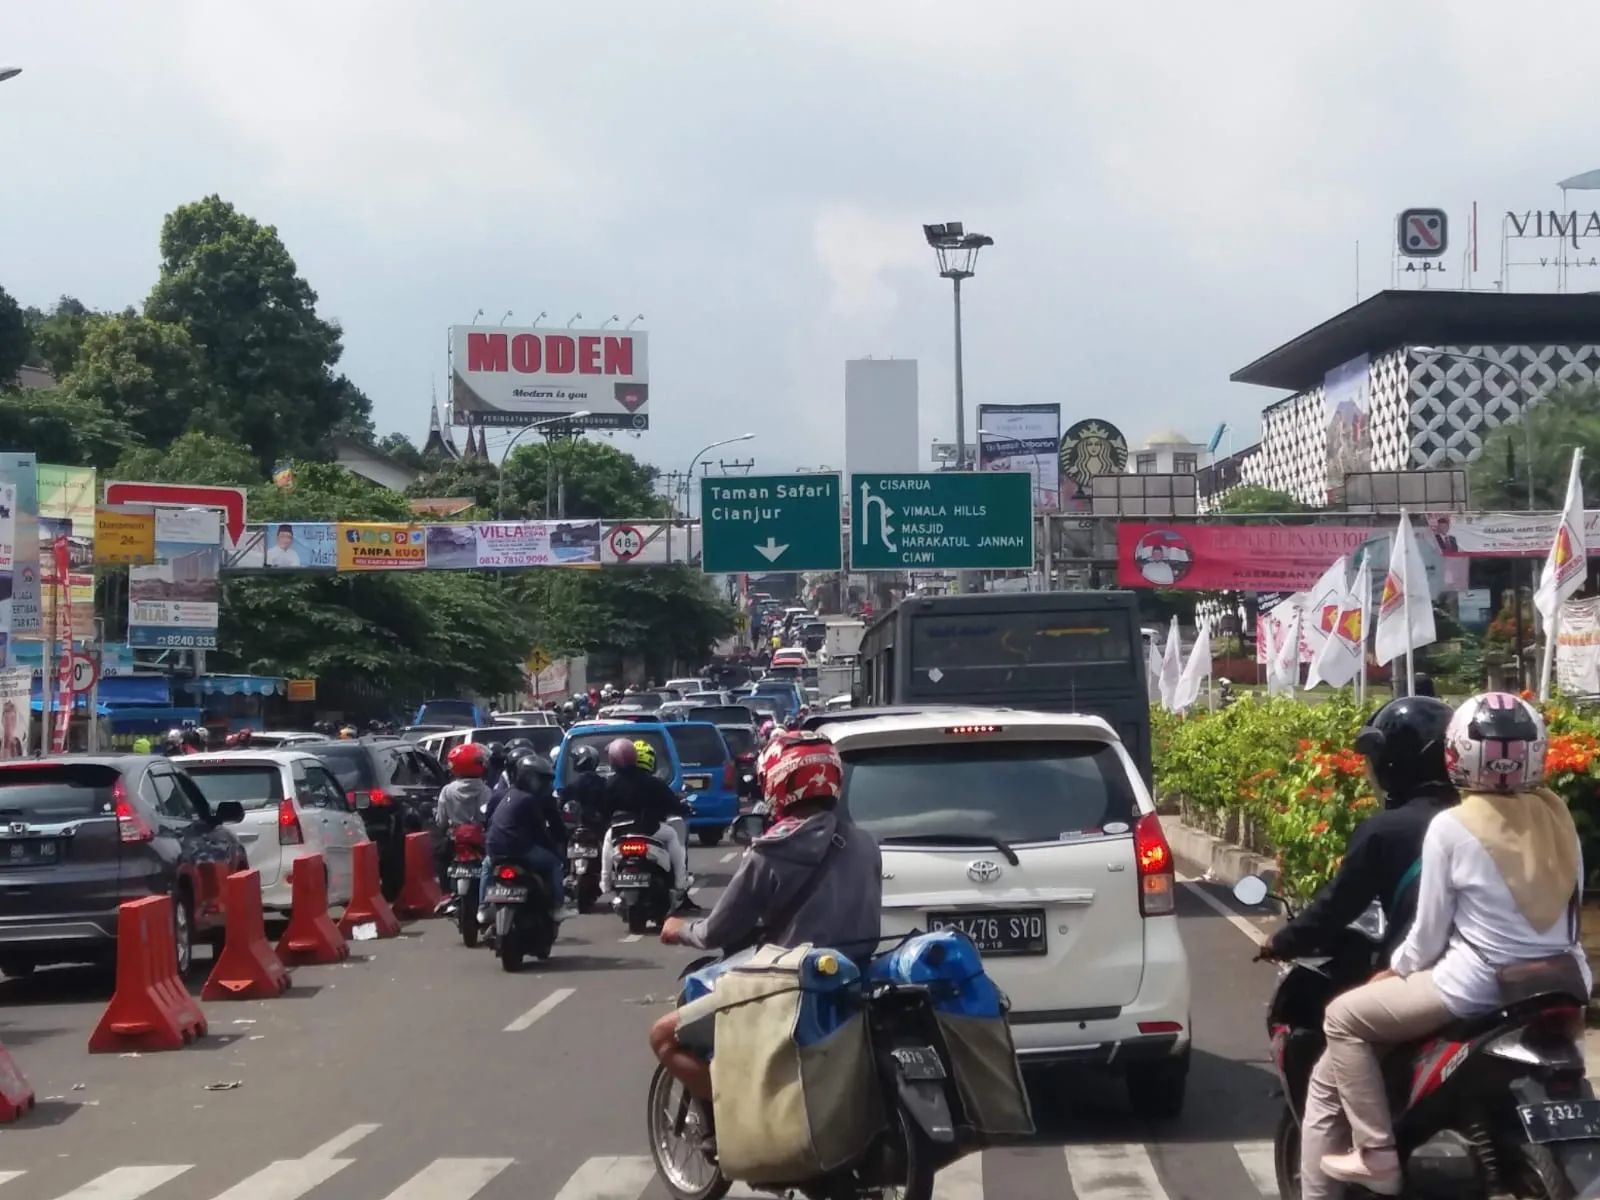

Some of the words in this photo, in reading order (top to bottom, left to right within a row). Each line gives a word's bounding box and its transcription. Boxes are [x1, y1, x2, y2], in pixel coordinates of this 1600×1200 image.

[1406, 262, 1446, 272] APL
[468, 332, 633, 375] MODEN
[512, 388, 553, 399] Modern
[556, 389, 566, 399] is
[568, 392, 588, 401] you
[879, 480, 931, 490] CISARUA
[711, 487, 769, 500] Taman
[776, 485, 831, 499] Safari
[711, 507, 782, 523] Cianjur
[902, 506, 946, 517] VIMALA
[953, 505, 987, 516] HILLS
[479, 526, 524, 538] VILLA
[902, 524, 944, 535] MASJID
[902, 537, 970, 547] HARAKATUL
[977, 536, 1024, 547] JANNAH
[353, 547, 391, 556] TANPA
[480, 555, 501, 565] 0812
[902, 553, 935, 563] CIAWI
[167, 635, 194, 646] 8240
[196, 635, 217, 647] 333
[1010, 917, 1041, 938] SYD
[1522, 1108, 1534, 1124] F
[1544, 1103, 1585, 1120] 2322
